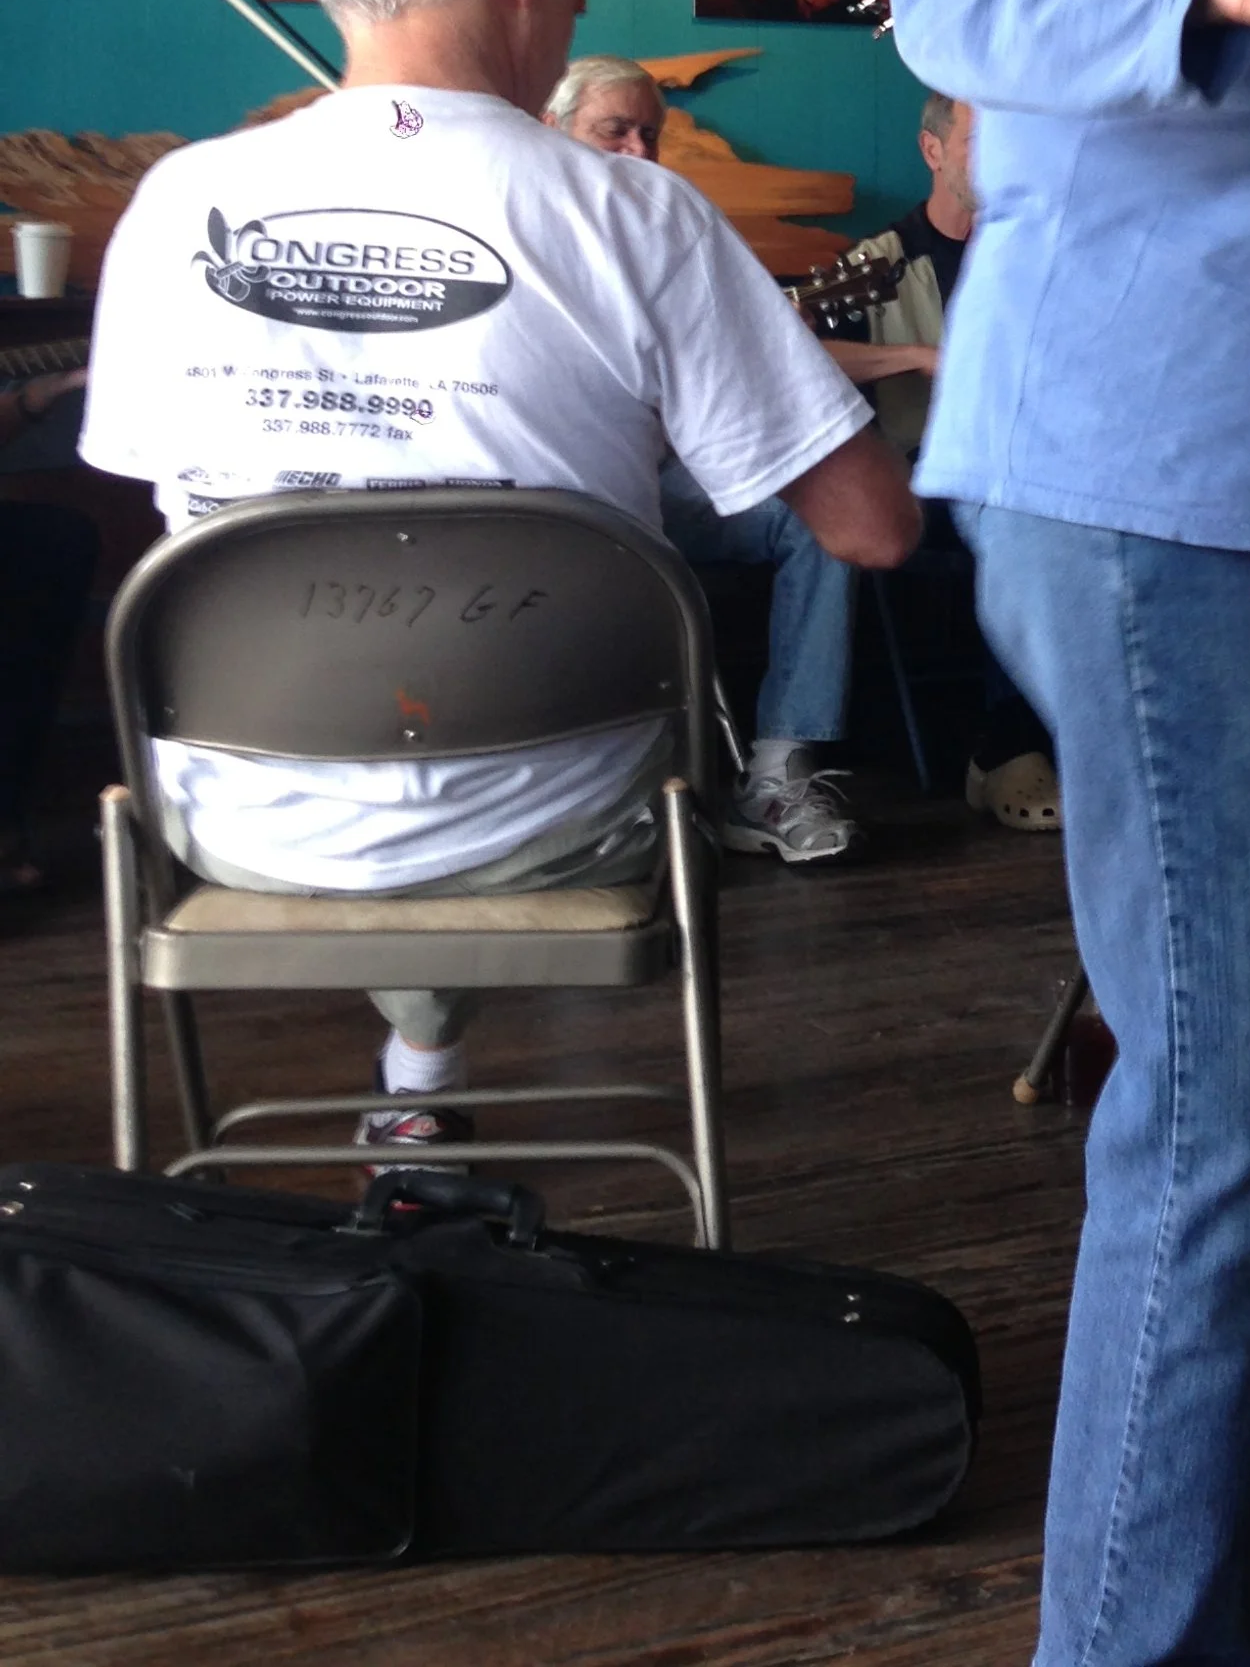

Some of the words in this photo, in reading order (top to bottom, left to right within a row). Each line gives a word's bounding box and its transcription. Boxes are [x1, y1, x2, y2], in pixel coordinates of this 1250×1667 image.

[268, 269, 447, 300] OUTDOOR
[269, 289, 342, 306] POWER
[344, 290, 444, 312] EQUIPMENT
[244, 365, 313, 382] ongress
[316, 367, 336, 382] St
[451, 379, 500, 397] 70506
[245, 387, 435, 420] 337.988.9990
[262, 418, 382, 439] 337.988.7772
[385, 424, 415, 442] fax
[302, 581, 437, 628] 13767
